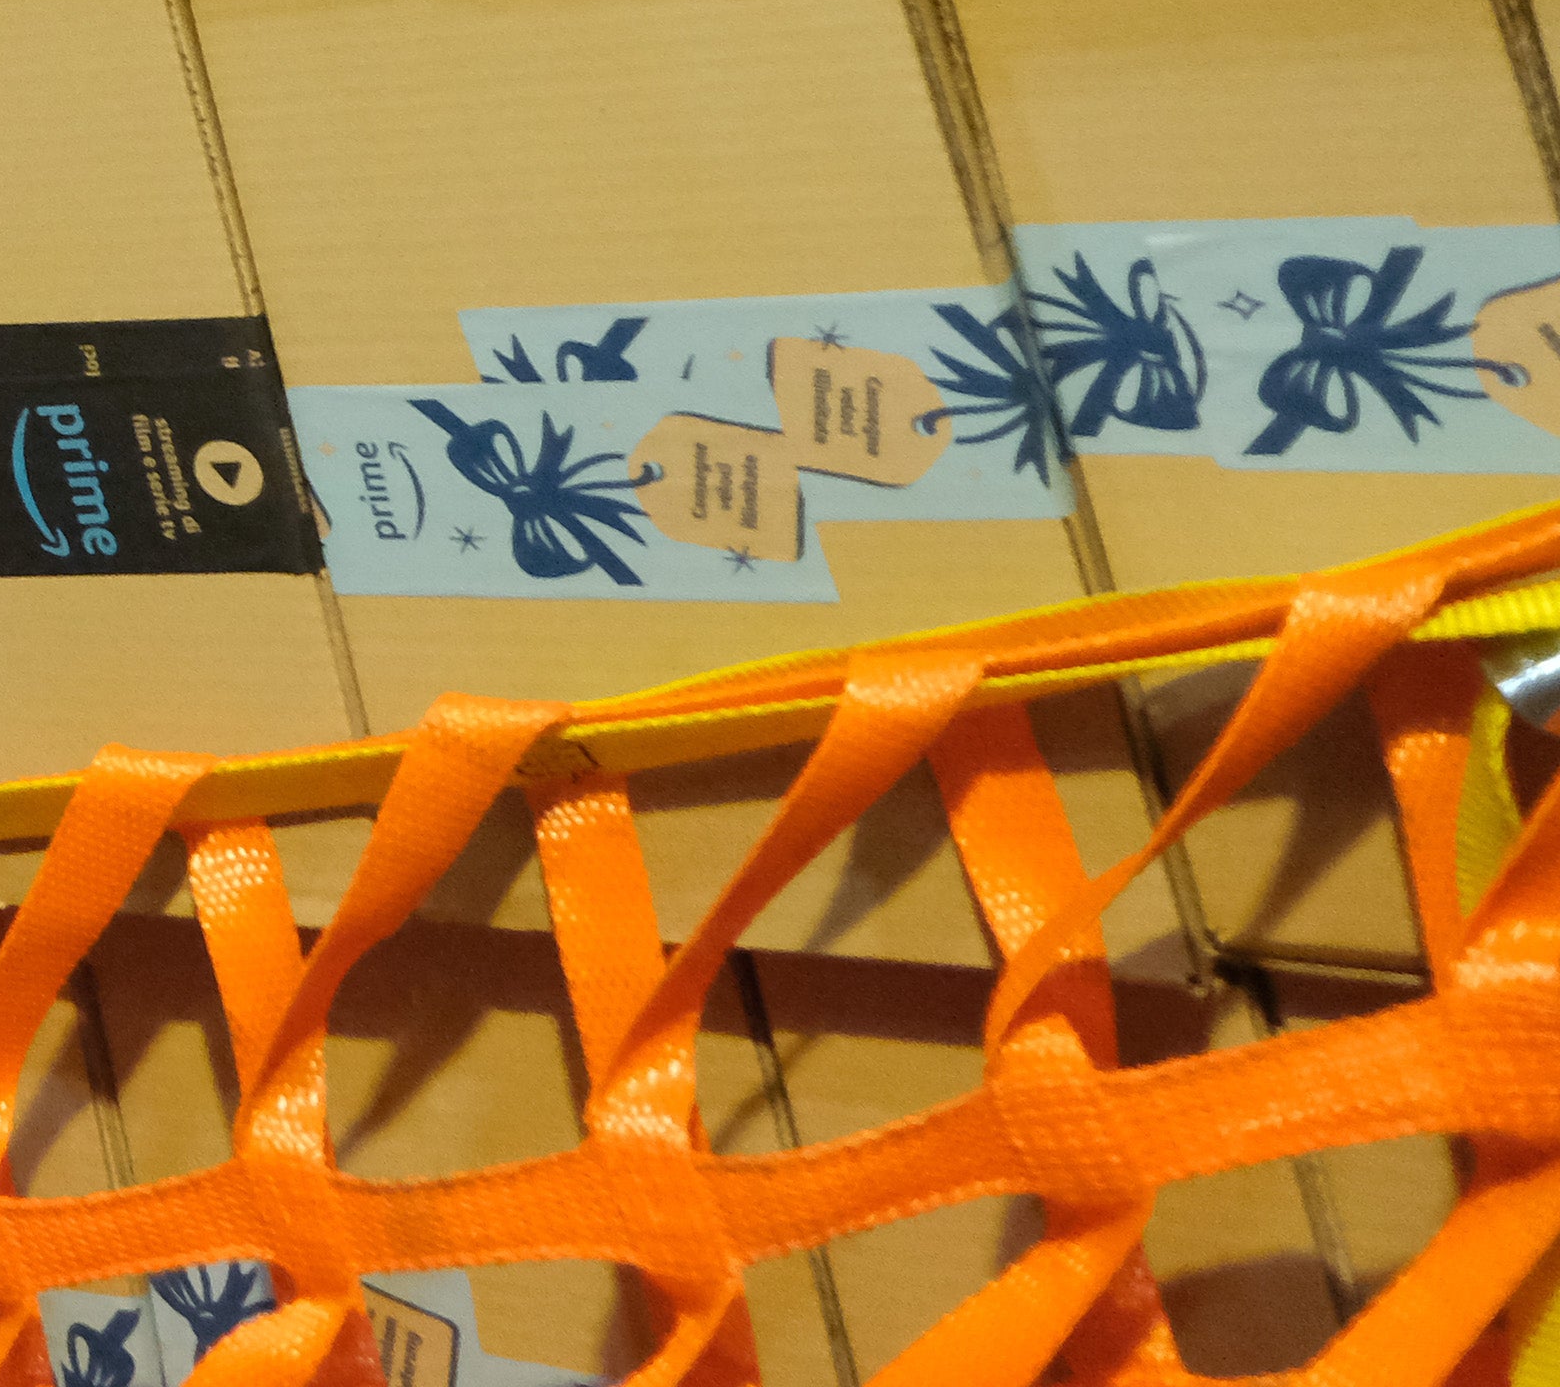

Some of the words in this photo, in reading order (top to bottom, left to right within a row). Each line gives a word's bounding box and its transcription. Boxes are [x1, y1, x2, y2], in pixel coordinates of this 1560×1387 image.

[36, 404, 119, 557] prime
[131, 413, 153, 453] film
[146, 471, 171, 516] serie
[159, 519, 178, 541] tv
[153, 416, 192, 511] streaming
[181, 514, 203, 534] di
[355, 440, 407, 541] prime
